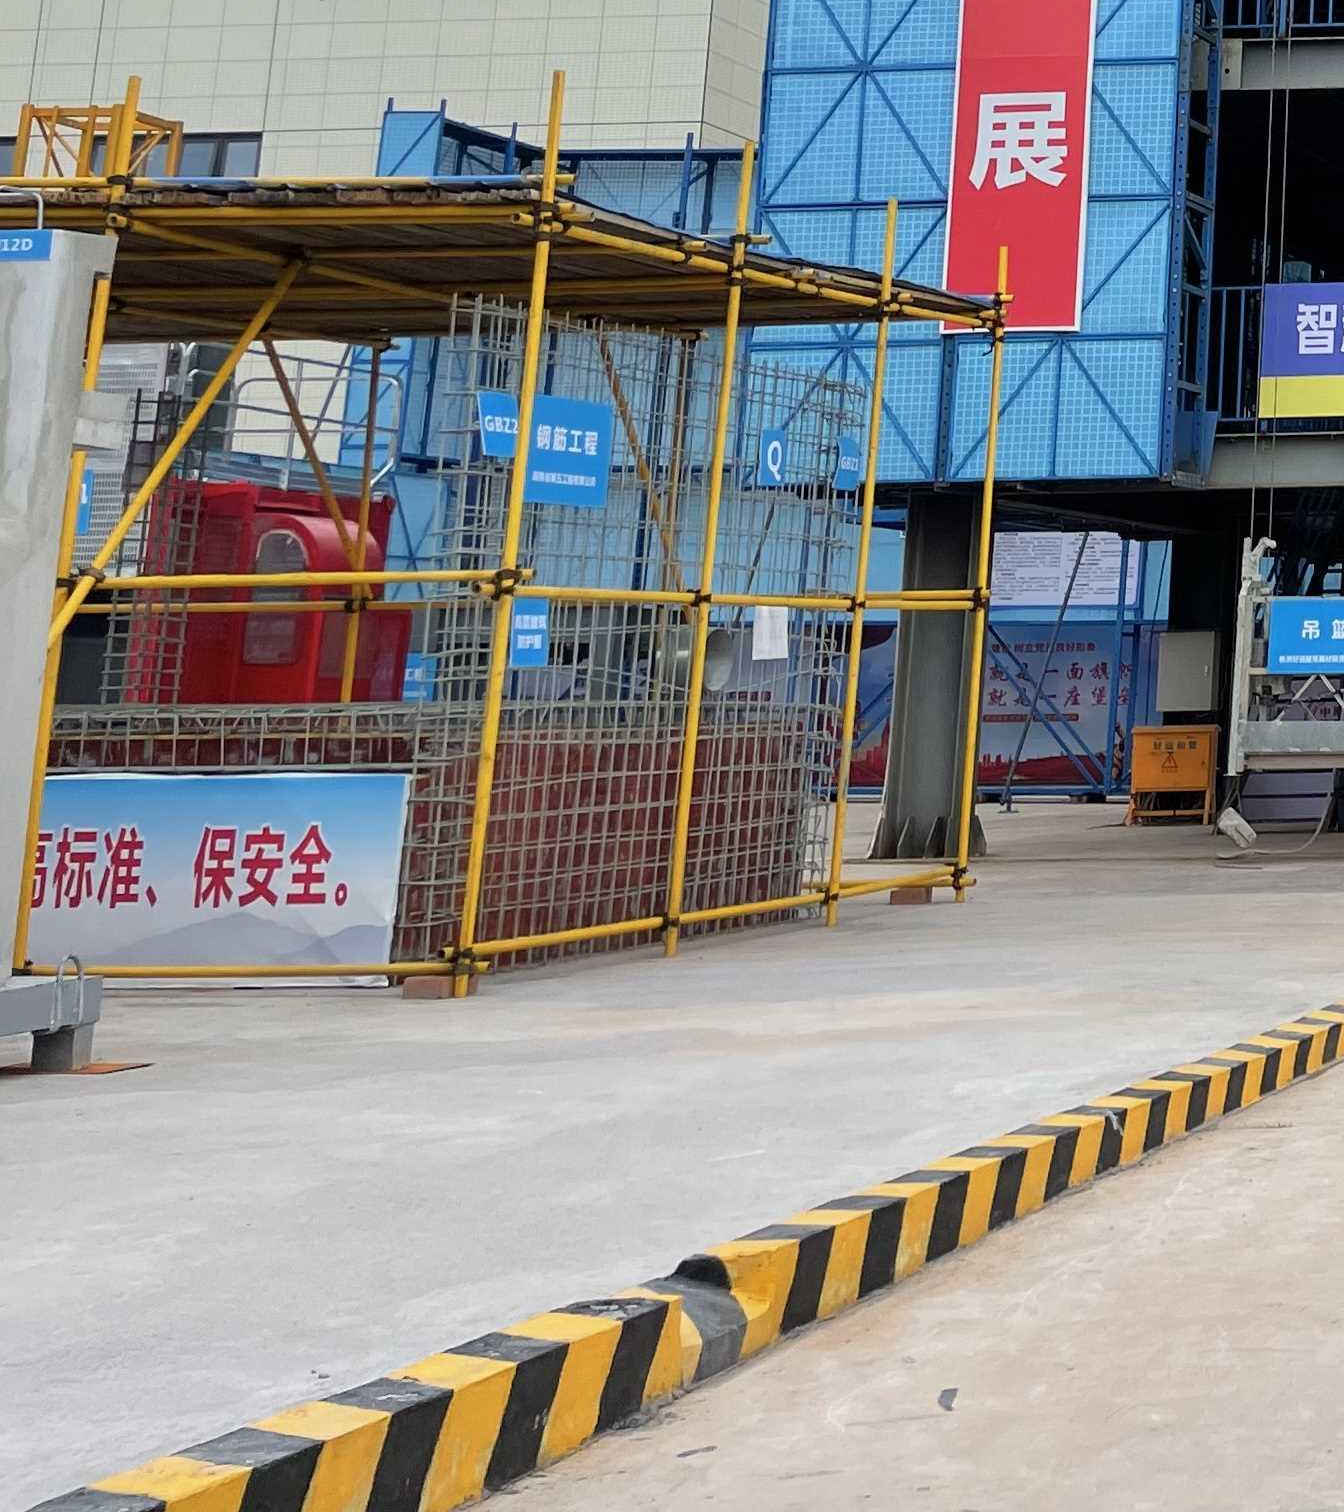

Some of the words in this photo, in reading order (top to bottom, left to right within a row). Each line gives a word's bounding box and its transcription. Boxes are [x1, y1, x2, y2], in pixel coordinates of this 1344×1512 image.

[0, 237, 33, 252] 12D
[537, 423, 599, 456] 钢筋工程
[767, 440, 783, 482] Q
